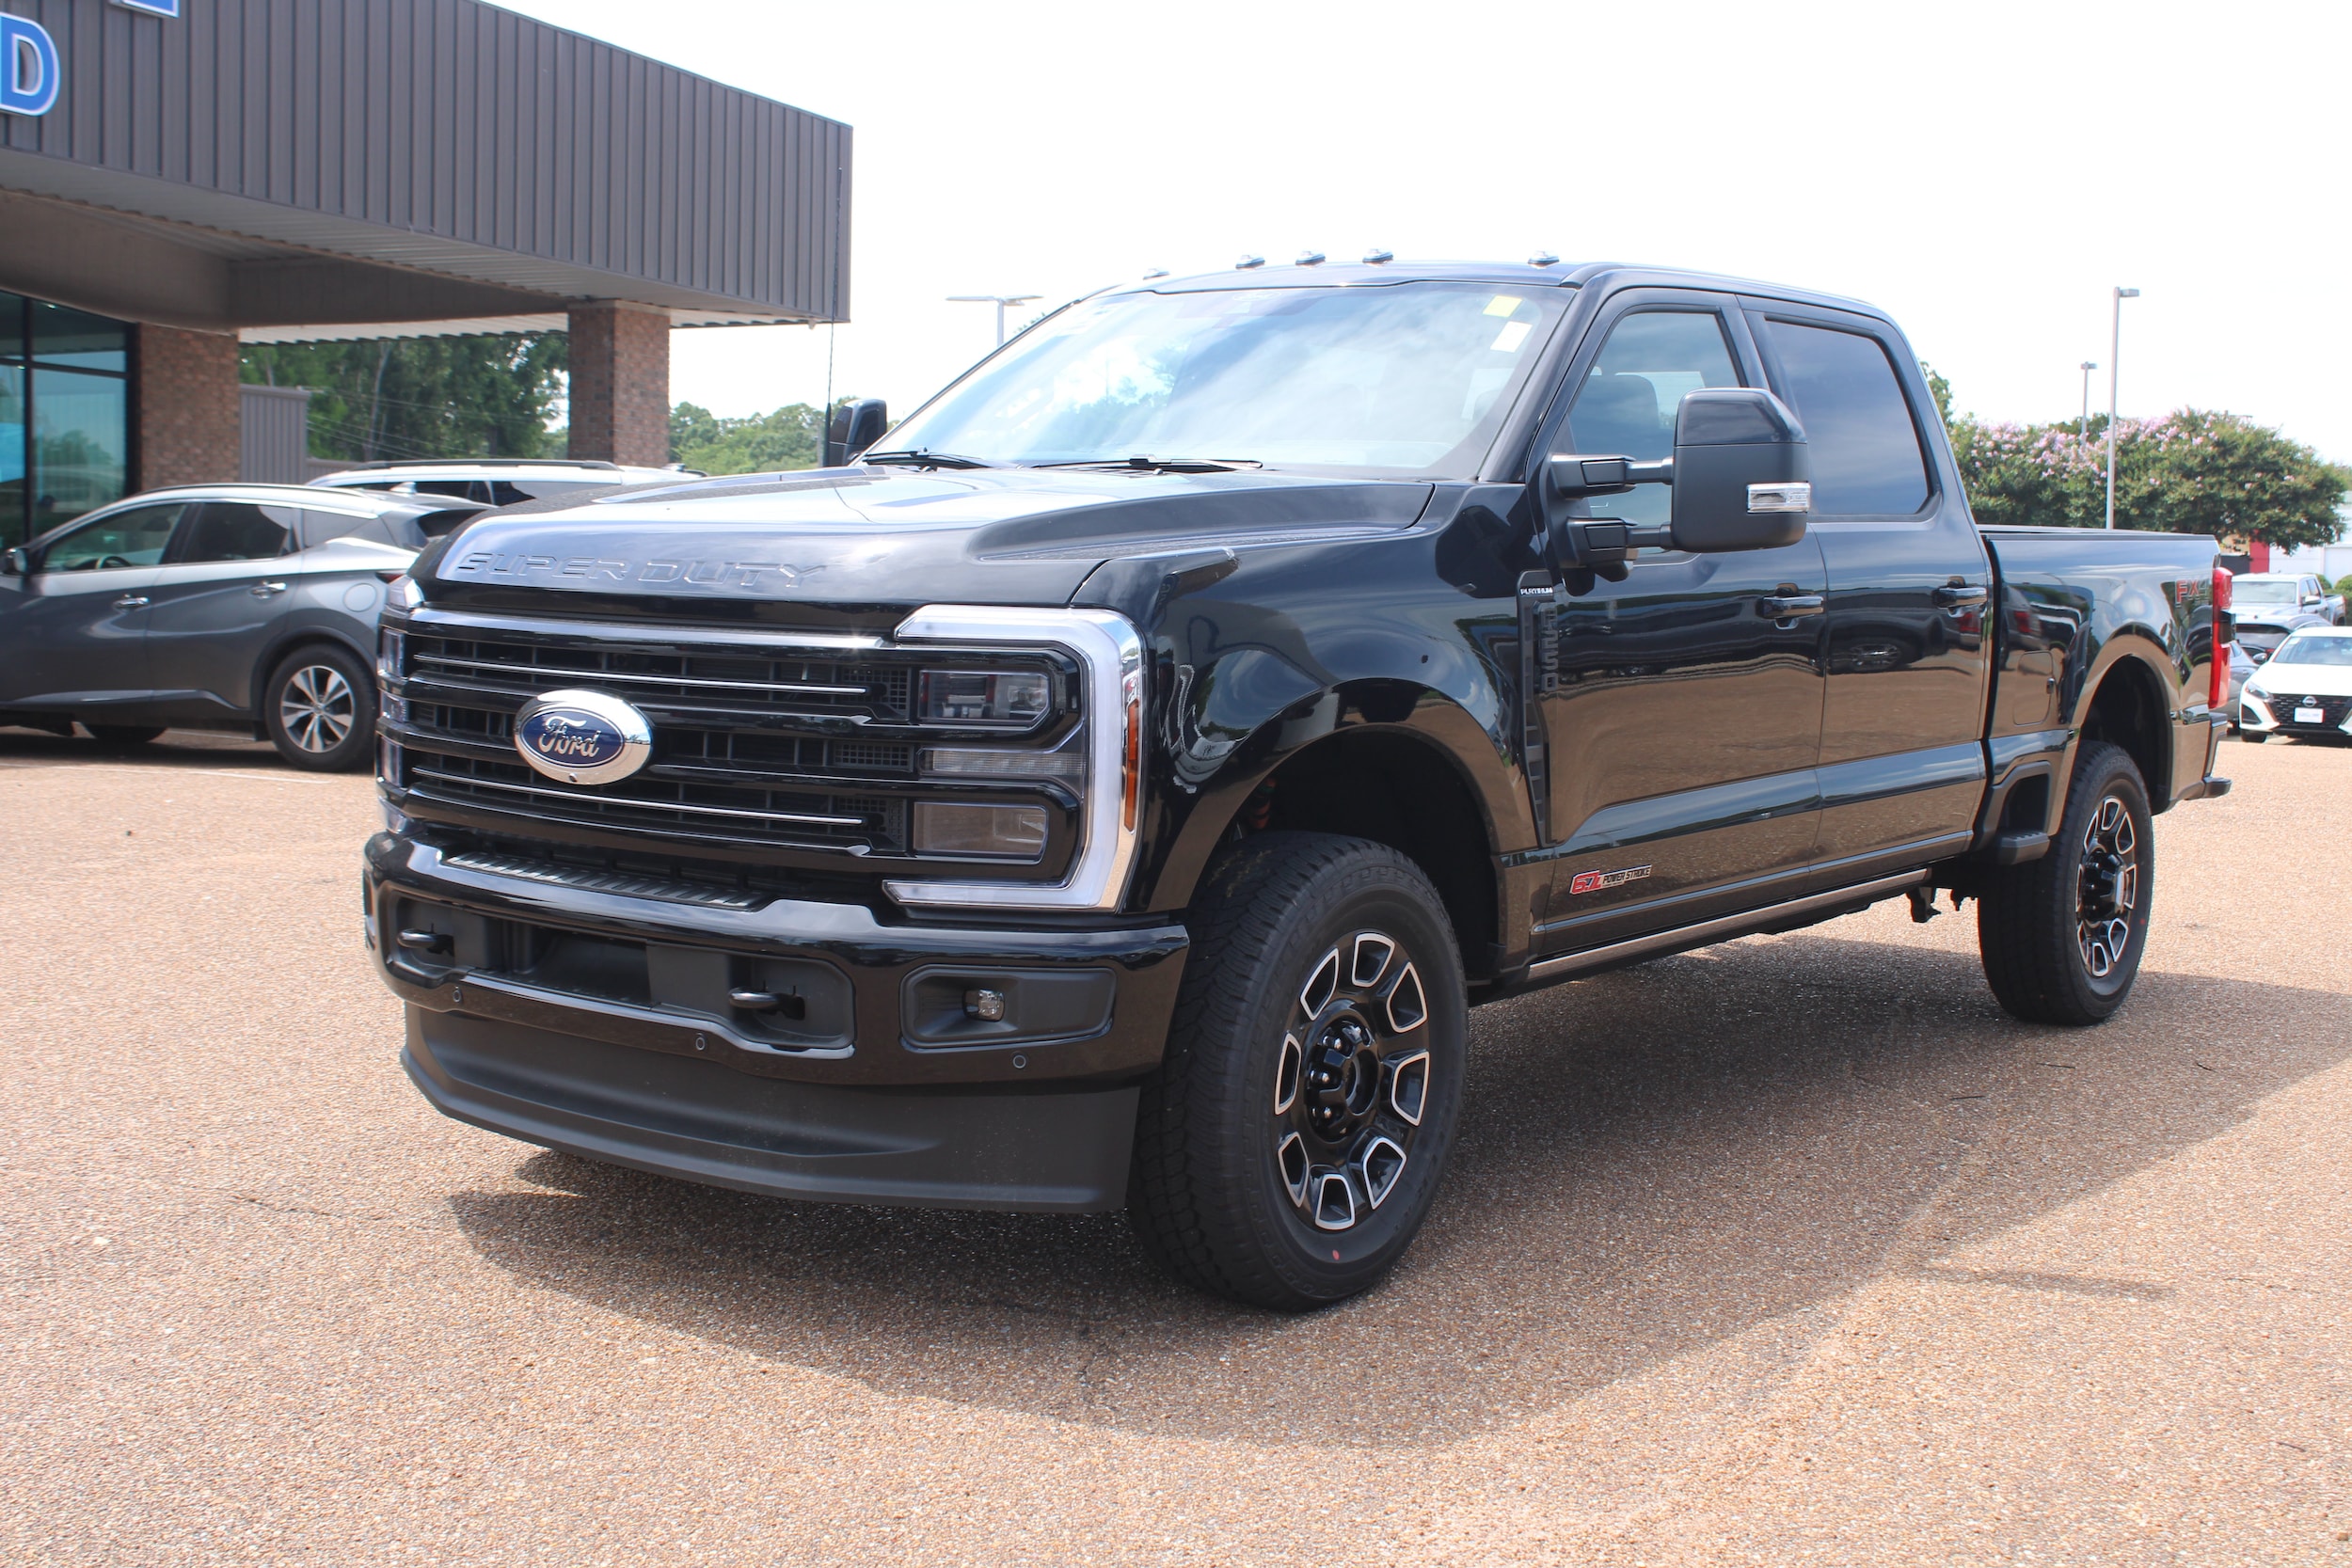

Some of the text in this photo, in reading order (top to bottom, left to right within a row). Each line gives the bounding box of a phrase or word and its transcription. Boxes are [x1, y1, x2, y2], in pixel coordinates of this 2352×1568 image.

[457, 552, 826, 588] SUPER DUTY
[538, 715, 602, 758] Ford
